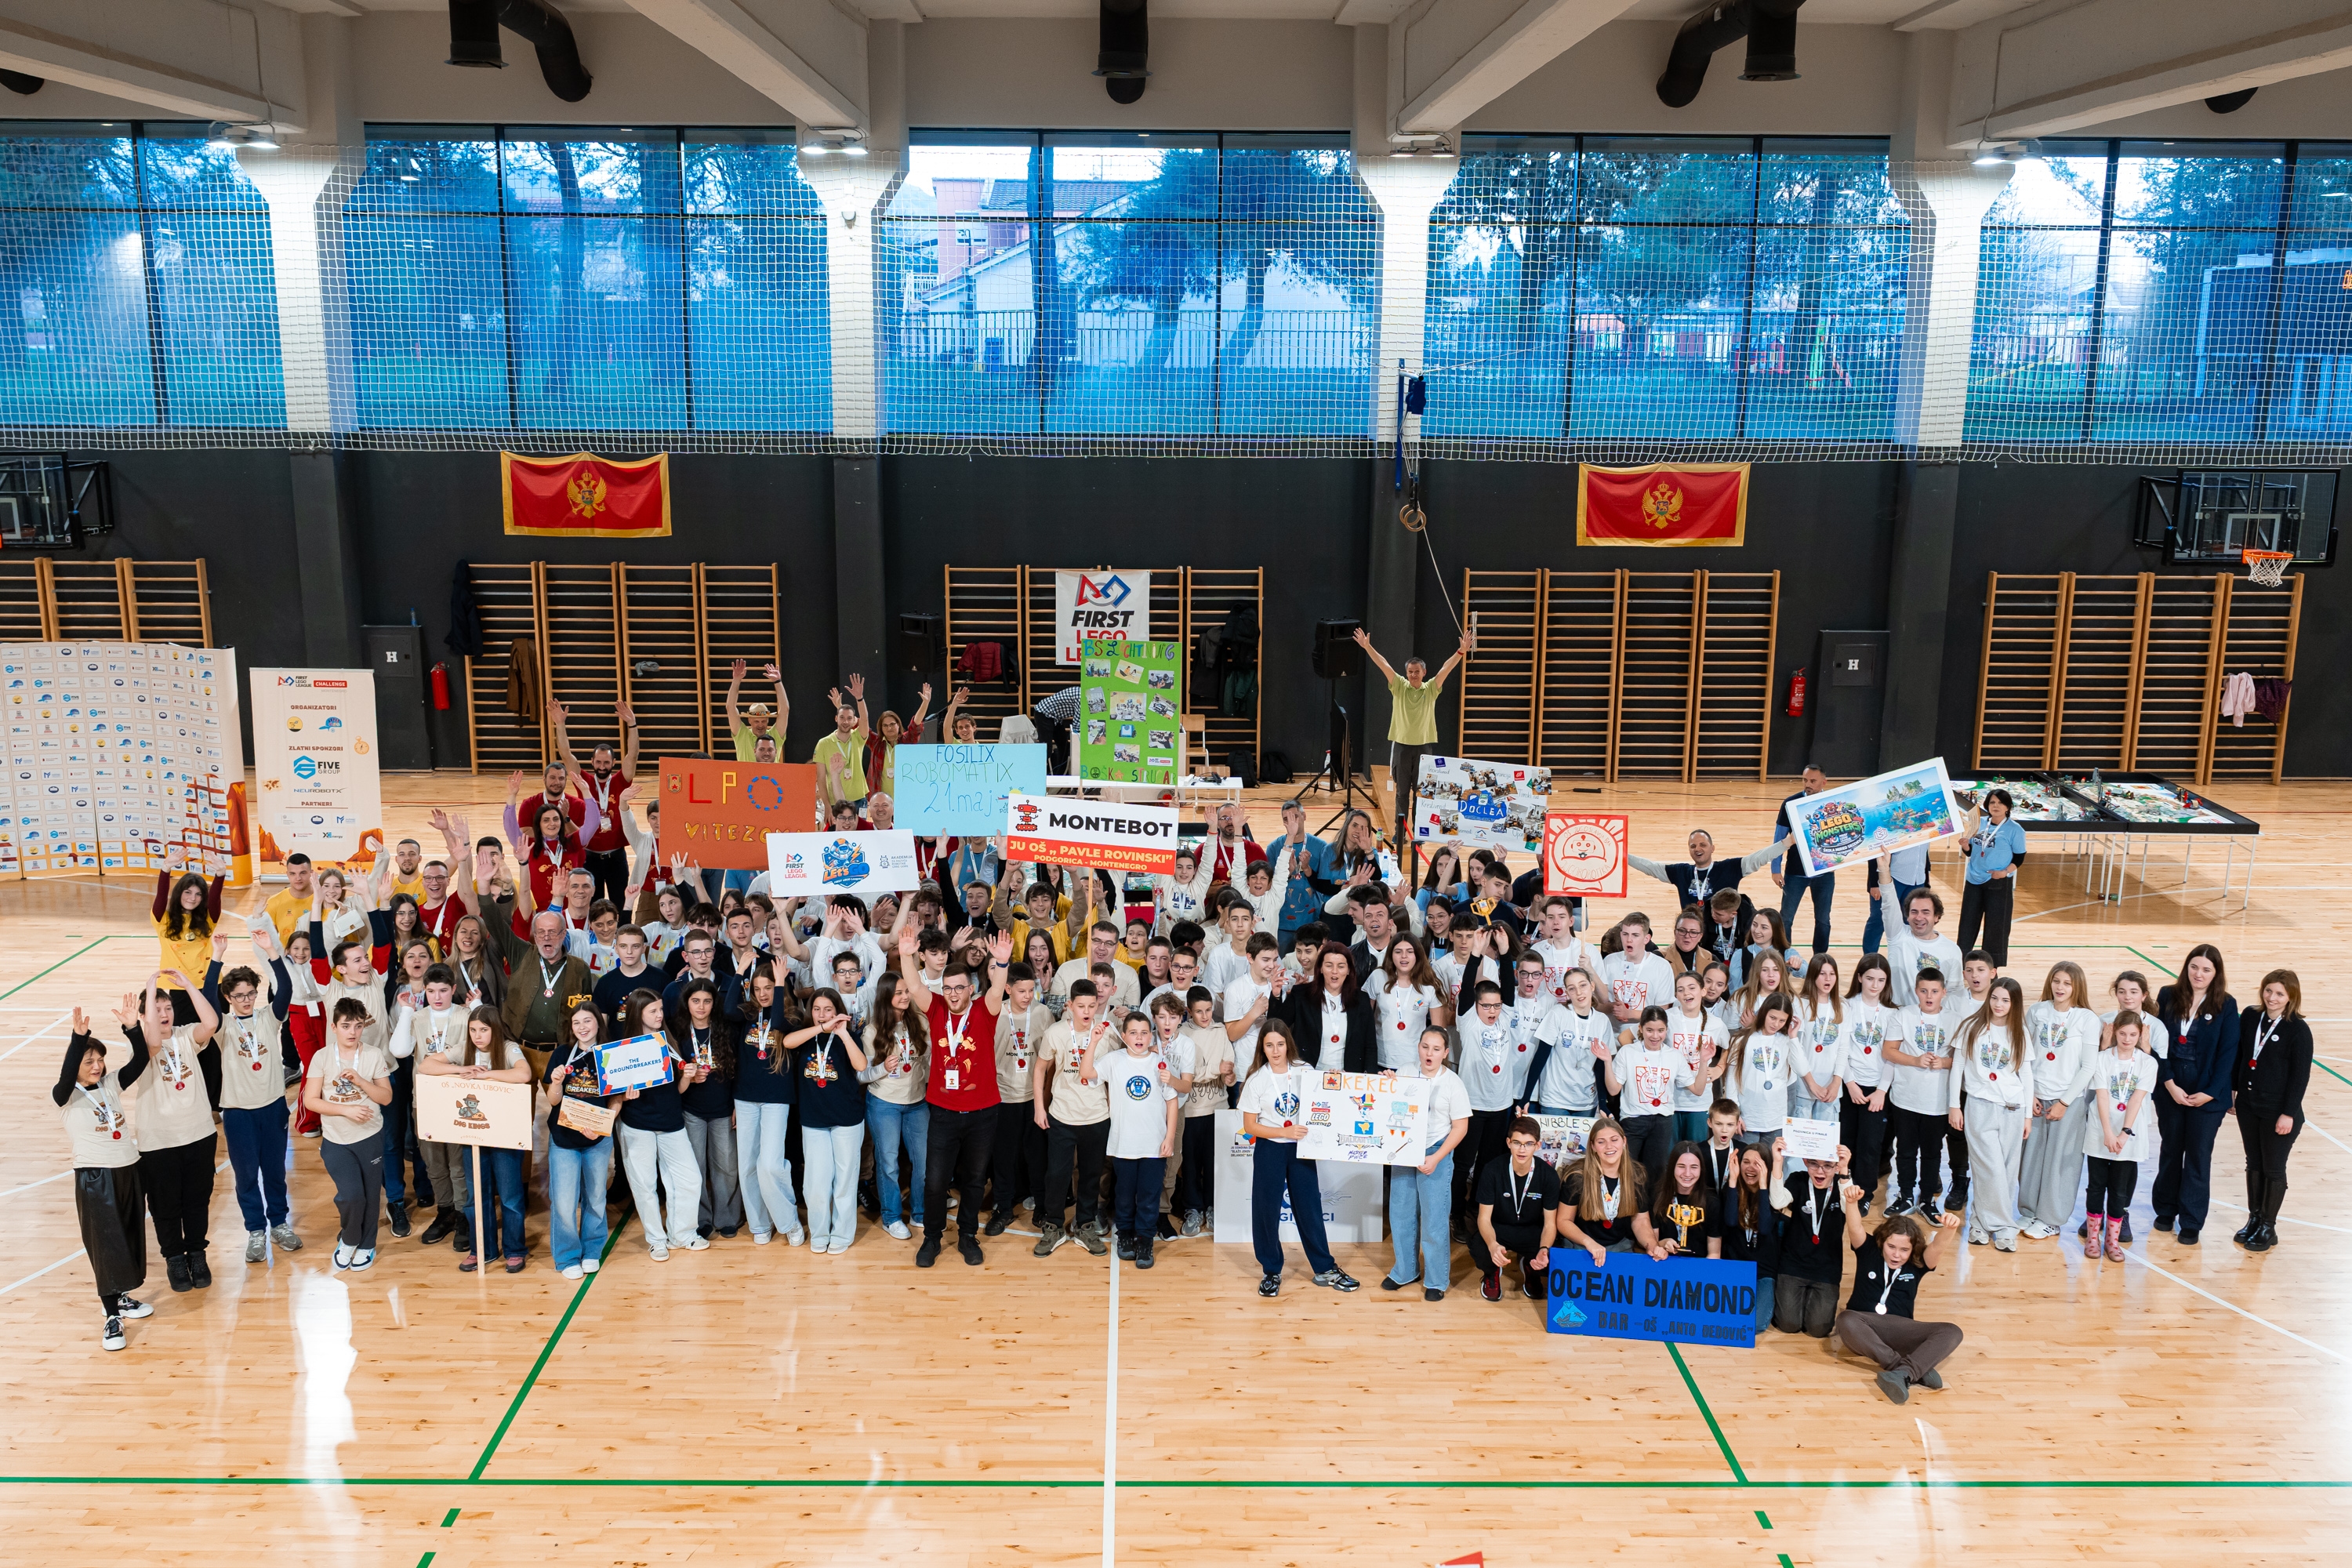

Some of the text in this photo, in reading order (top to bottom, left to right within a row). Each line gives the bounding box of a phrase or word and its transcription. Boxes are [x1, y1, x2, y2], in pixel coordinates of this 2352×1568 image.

[1071, 610, 1134, 628] FIRST
[1076, 630, 1127, 644] LEGO
[1083, 640, 1103, 656] BS
[386, 652, 397, 662] H
[1848, 659, 1859, 670] H
[936, 745, 995, 764] FOSILIX
[902, 761, 1014, 783] ROBOMATIX
[1459, 800, 1504, 818] DOCLEA
[1049, 812, 1173, 837] MONTEBOT
[1820, 814, 1852, 830] LEGO
[685, 822, 802, 844] VITEZO
[1815, 822, 1862, 842] MONSTERS
[1010, 840, 1025, 851] JU
[1029, 840, 1047, 852] OŠ
[1059, 845, 1101, 858] PAVLE
[1034, 855, 1083, 866] PODGORICA
[1089, 859, 1148, 871] MONTENEGRO
[609, 1058, 662, 1074] GROUNDBREAKERS
[567, 1085, 601, 1094] BREAKERS
[1343, 1075, 1398, 1094] KEKEC
[454, 1120, 466, 1128] DIG
[1311, 1112, 1330, 1122] LEGO
[1539, 1116, 1592, 1132] NIBBLES
[1549, 1268, 1756, 1316] OCEAN DIAMOND
[1598, 1311, 1629, 1331] BAR
[1643, 1316, 1657, 1333] OŠ
